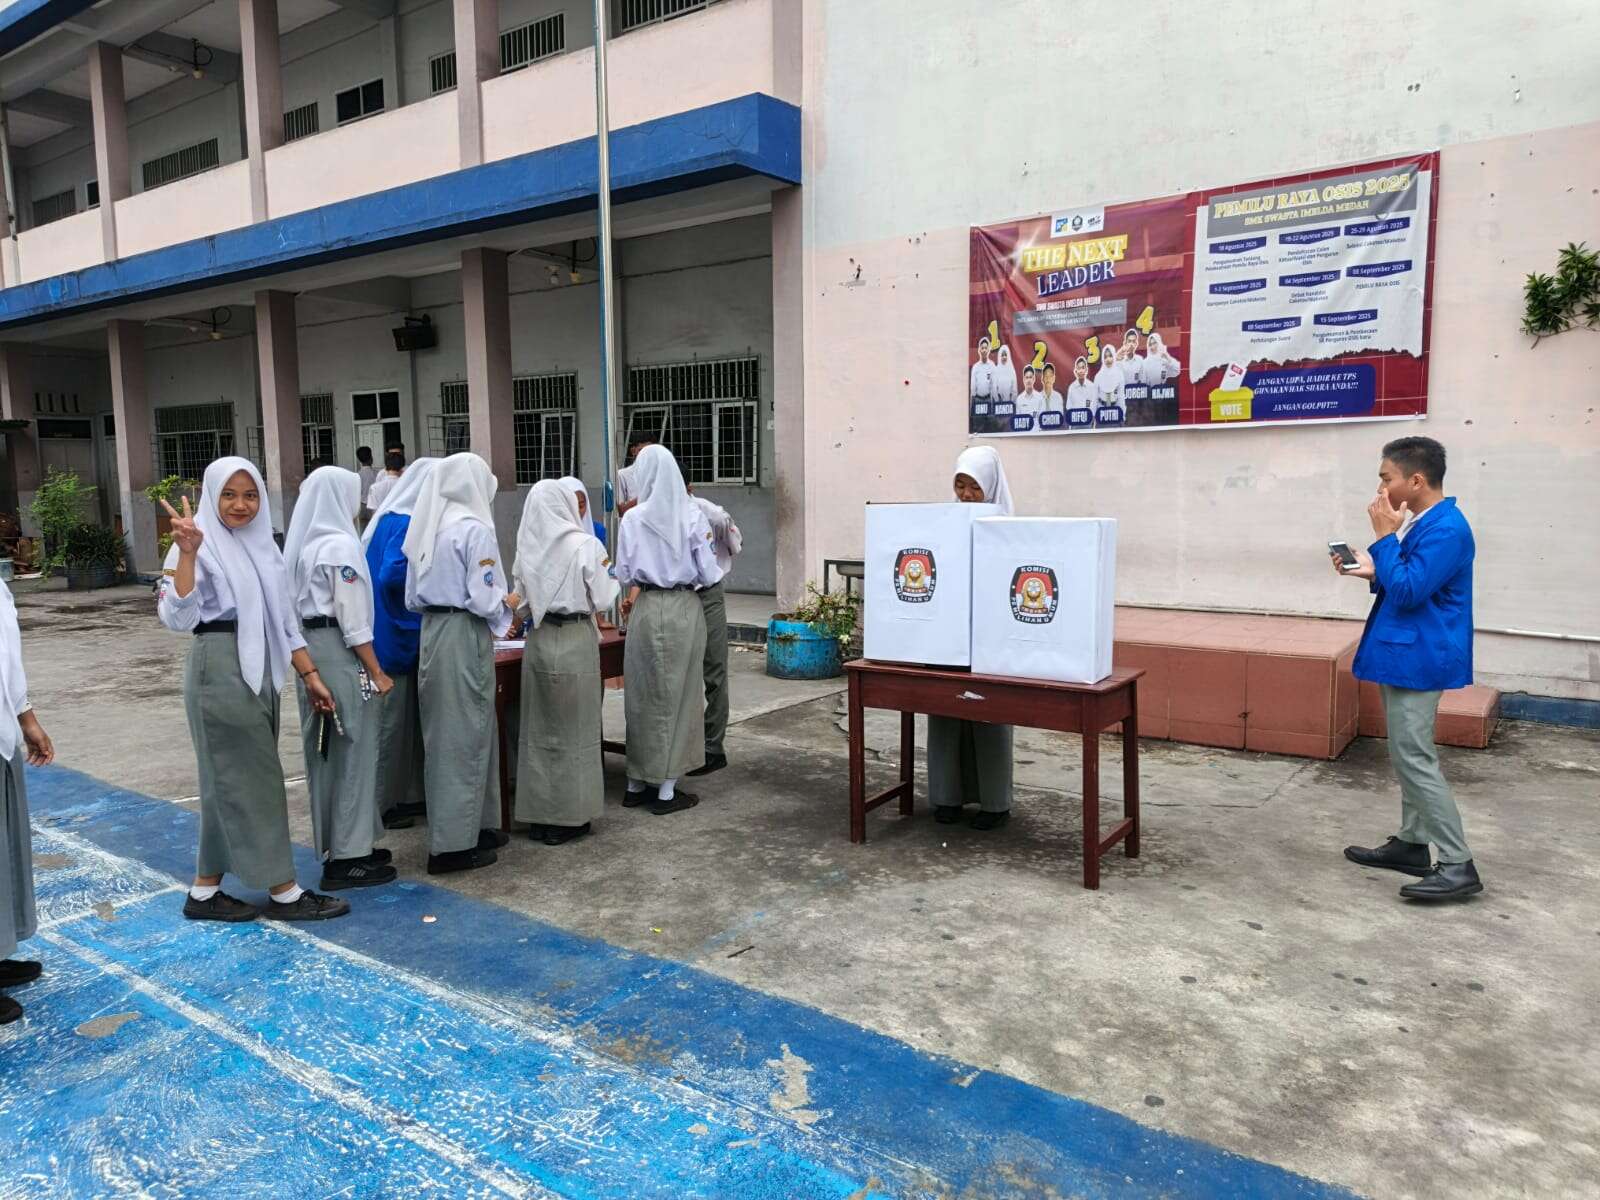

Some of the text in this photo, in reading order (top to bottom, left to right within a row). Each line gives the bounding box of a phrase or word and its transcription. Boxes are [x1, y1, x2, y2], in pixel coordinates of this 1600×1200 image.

[1214, 173, 1410, 219] PEMILU RAYA OSIS 2025
[1244, 200, 1369, 225] SMK SWASTA IMELDA MEDAN
[1023, 237, 1125, 270] THE NEXT
[1360, 266, 1391, 275] September
[1036, 260, 1116, 296] LEADER
[1136, 306, 1154, 334] 4
[1327, 314, 1357, 323] September
[1254, 322, 1282, 330] September
[988, 320, 1001, 350] 1
[1032, 341, 1048, 370] 2
[1085, 336, 1100, 364] 3
[1257, 376, 1285, 385] JANGAN
[1306, 374, 1332, 383] HADIR
[1332, 373, 1342, 381] KE
[1342, 372, 1357, 381] TPS
[1254, 385, 1289, 395] GUNAKAN
[1289, 384, 1304, 393] HAK
[1305, 383, 1330, 392] SUARA
[1219, 403, 1242, 416] VOTE
[1272, 403, 1301, 412] JANGAN
[1100, 409, 1119, 421] PUTRI
[1021, 566, 1049, 574] KOMISI
